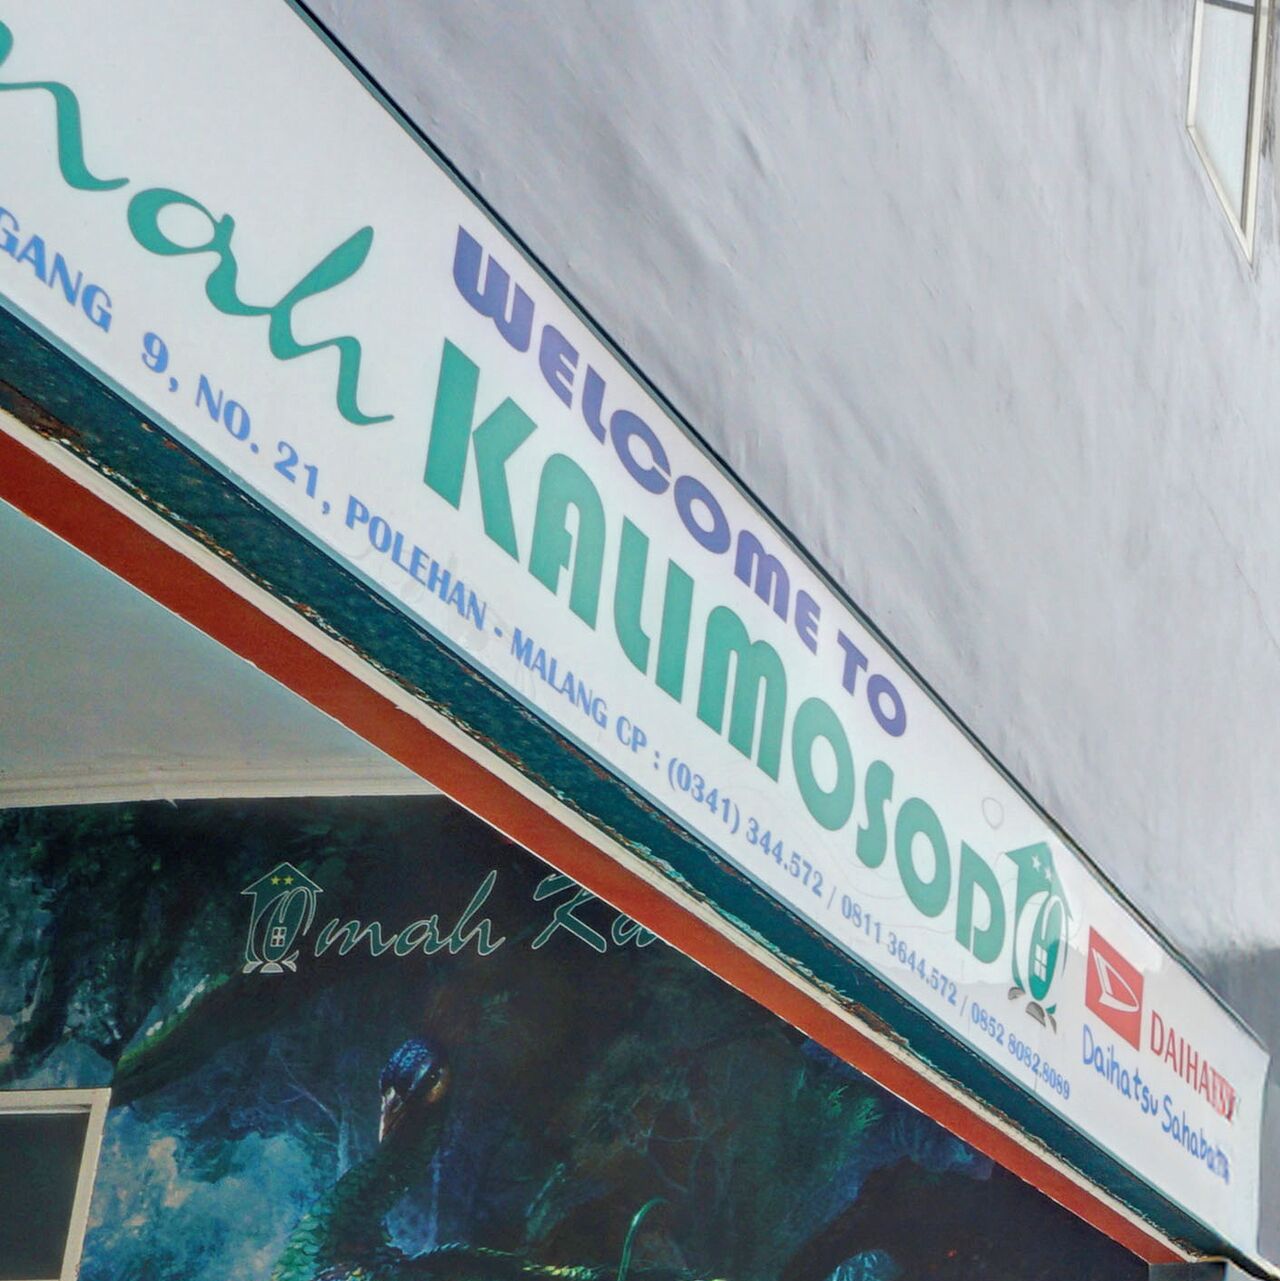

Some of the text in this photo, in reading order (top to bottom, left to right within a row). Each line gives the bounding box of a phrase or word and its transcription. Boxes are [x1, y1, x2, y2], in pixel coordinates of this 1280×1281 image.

[141, 331, 178, 393] 9,
[195, 373, 259, 455] NO.
[273, 441, 331, 515] 21,
[345, 494, 487, 632] POLEHAN
[511, 627, 608, 729] MALANG
[616, 715, 647, 752] CP
[668, 758, 740, 834] (0341)
[746, 817, 823, 897] 344.572
[841, 895, 882, 943] 0811
[888, 931, 958, 1006] 3644.572
[971, 1002, 1005, 1046] 0852
[452, 223, 907, 738] WELCOME TO
[1083, 1024, 1159, 1116] Daihatsu
